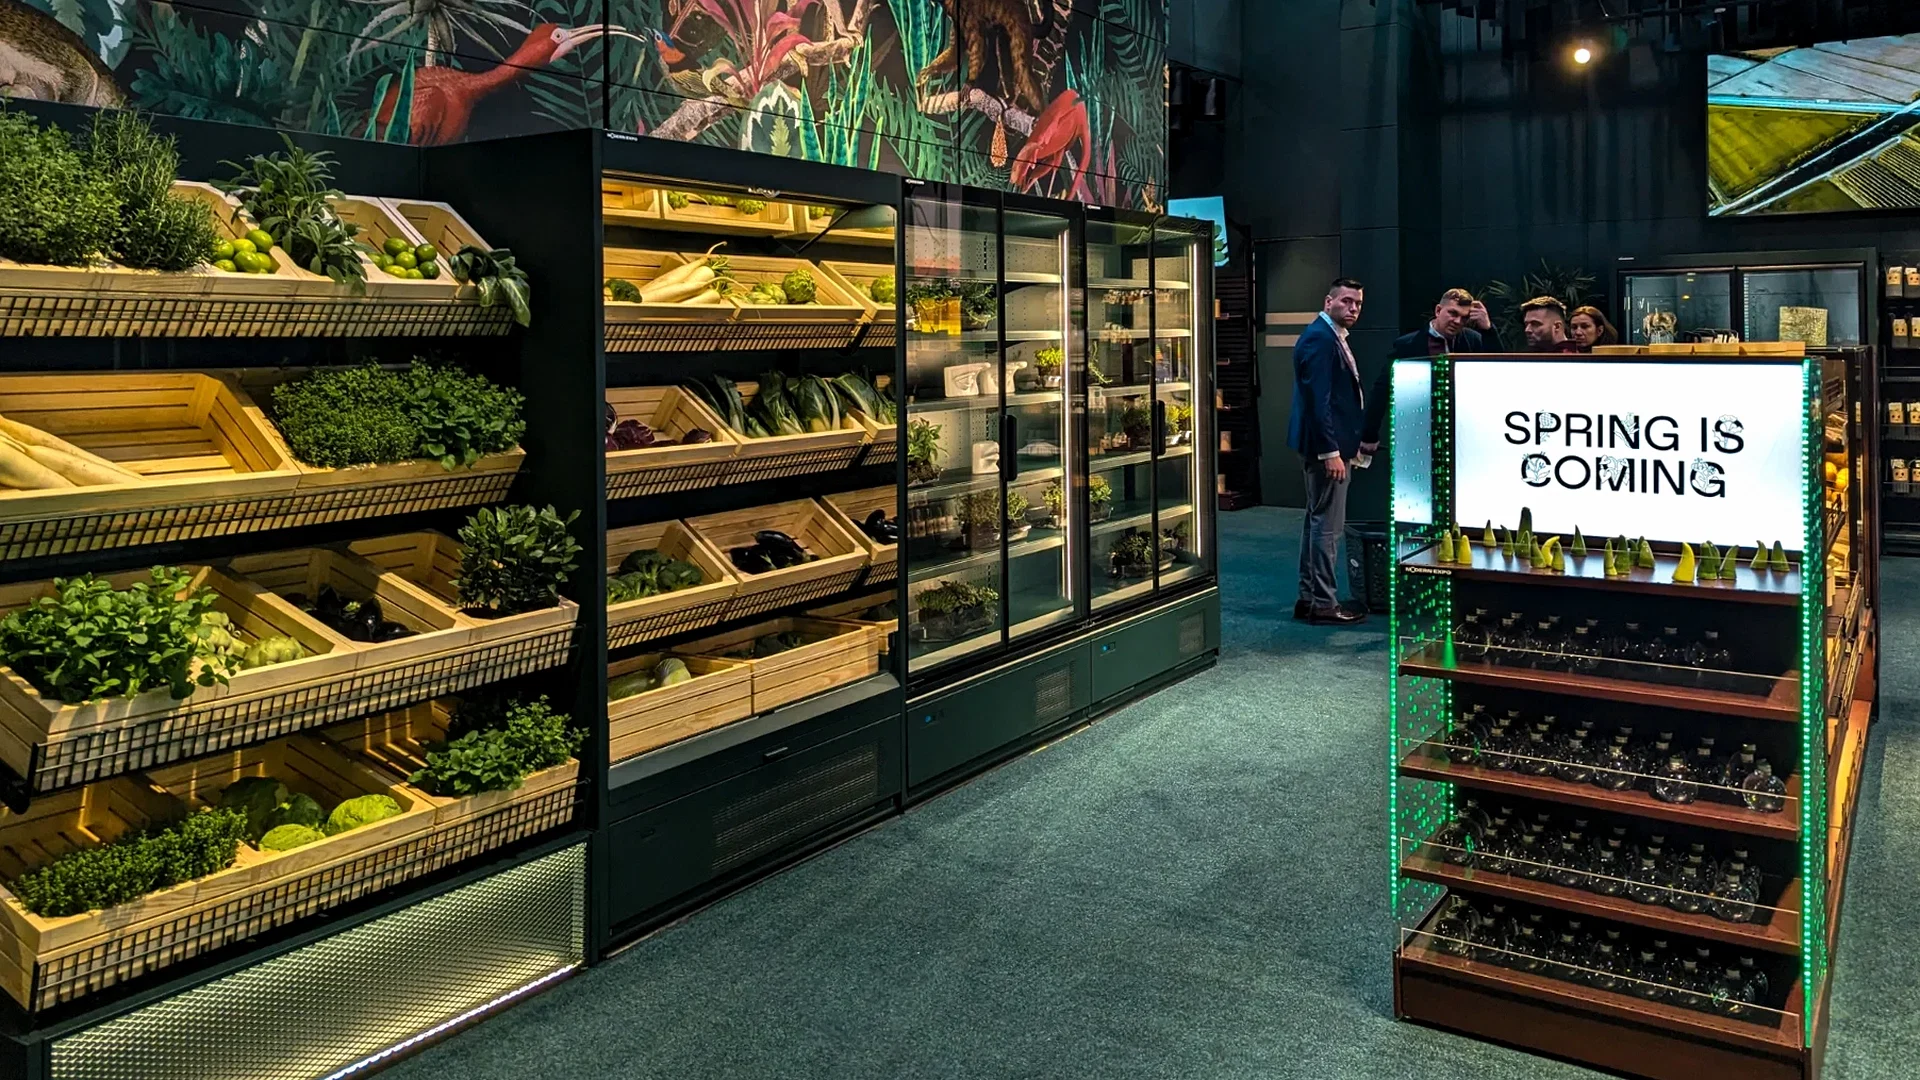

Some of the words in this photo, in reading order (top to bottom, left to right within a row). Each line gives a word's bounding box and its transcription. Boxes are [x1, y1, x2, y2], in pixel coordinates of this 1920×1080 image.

[1504, 410, 1680, 452] SPRING
[1700, 416, 1745, 455] IS
[1520, 451, 1726, 498] COMING
[1405, 566, 1433, 574] MODERN
